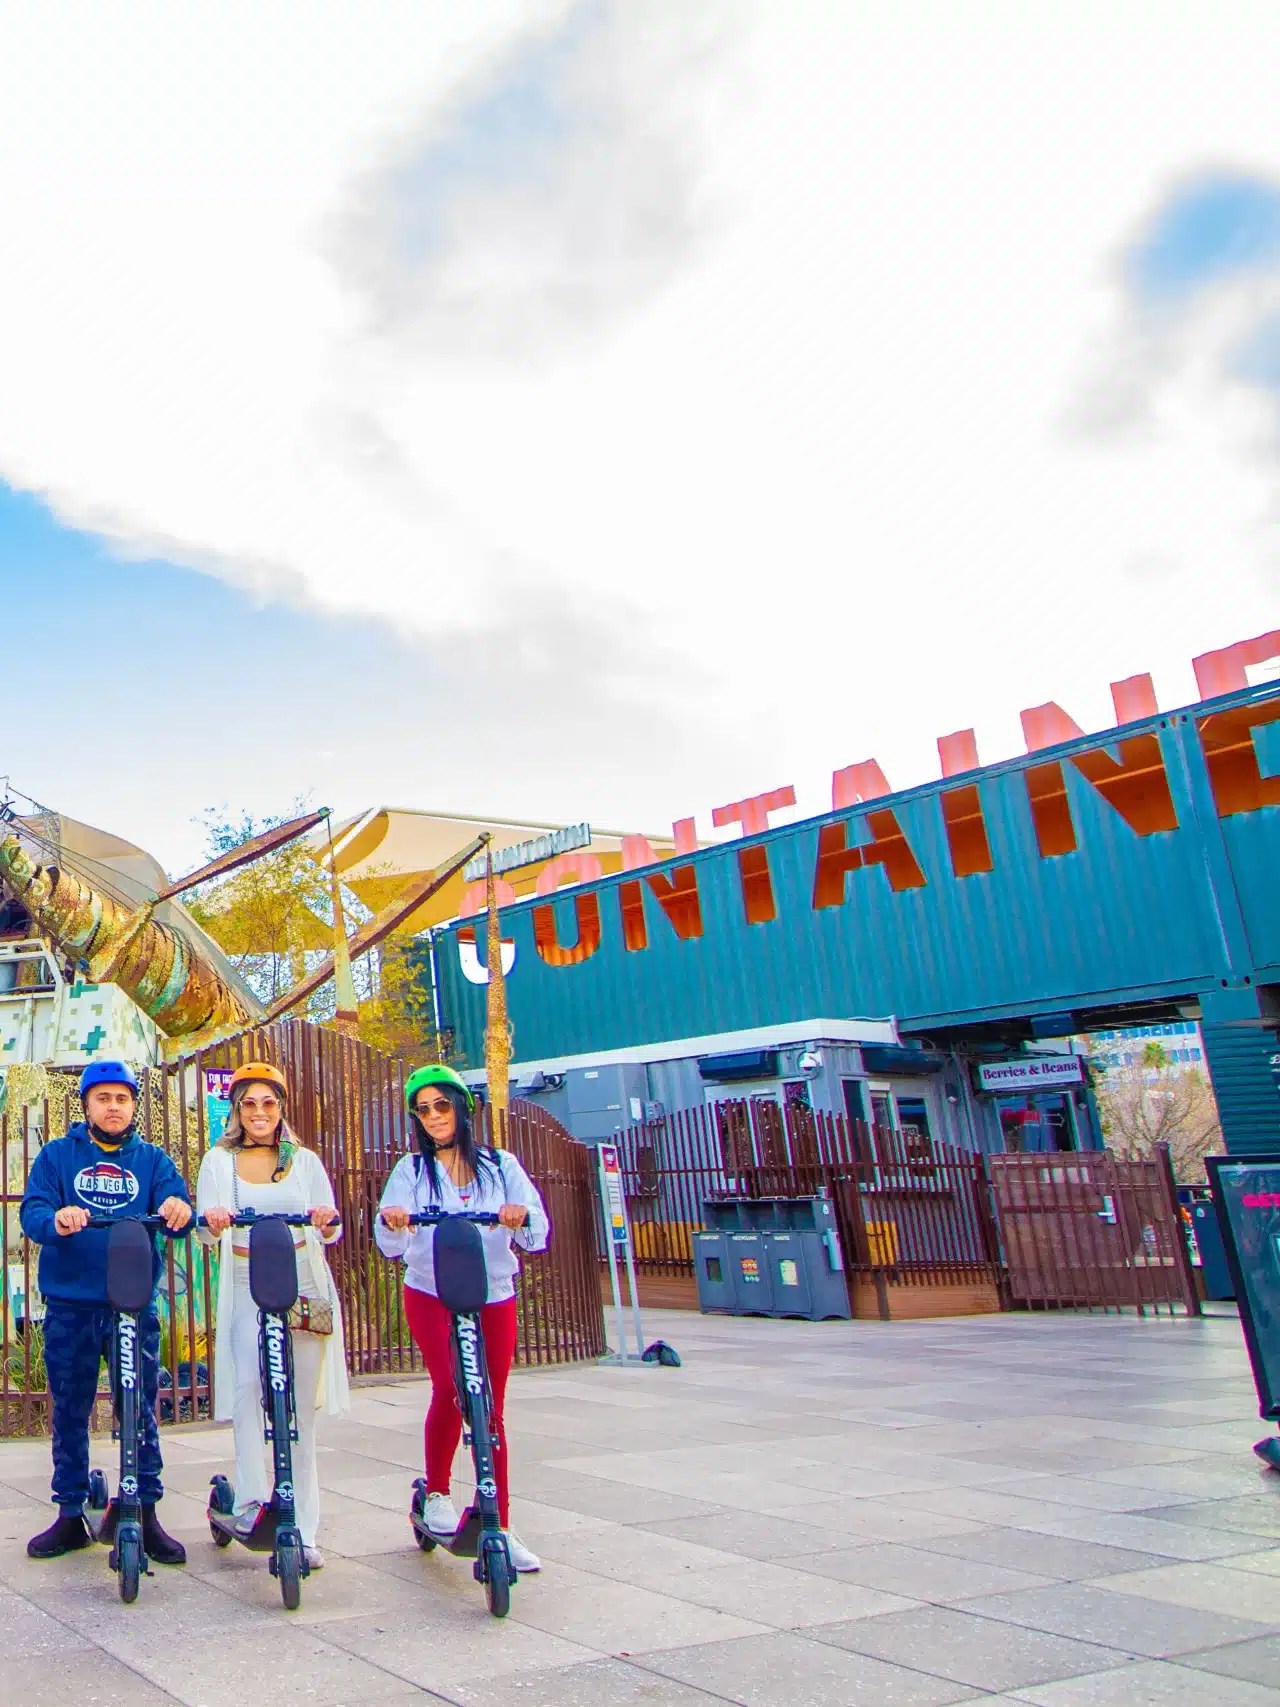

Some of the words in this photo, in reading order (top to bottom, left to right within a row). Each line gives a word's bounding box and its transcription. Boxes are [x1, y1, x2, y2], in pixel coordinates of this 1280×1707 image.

[983, 1067, 1026, 1080] Berries
[1028, 1065, 1040, 1076] &
[1042, 1062, 1078, 1074] Beans
[80, 1176, 99, 1190] LAS
[104, 1178, 134, 1193] VEGAS
[118, 1312, 137, 1389] Atomic
[265, 1313, 287, 1391] Atomic
[457, 1314, 483, 1394] Atomic
